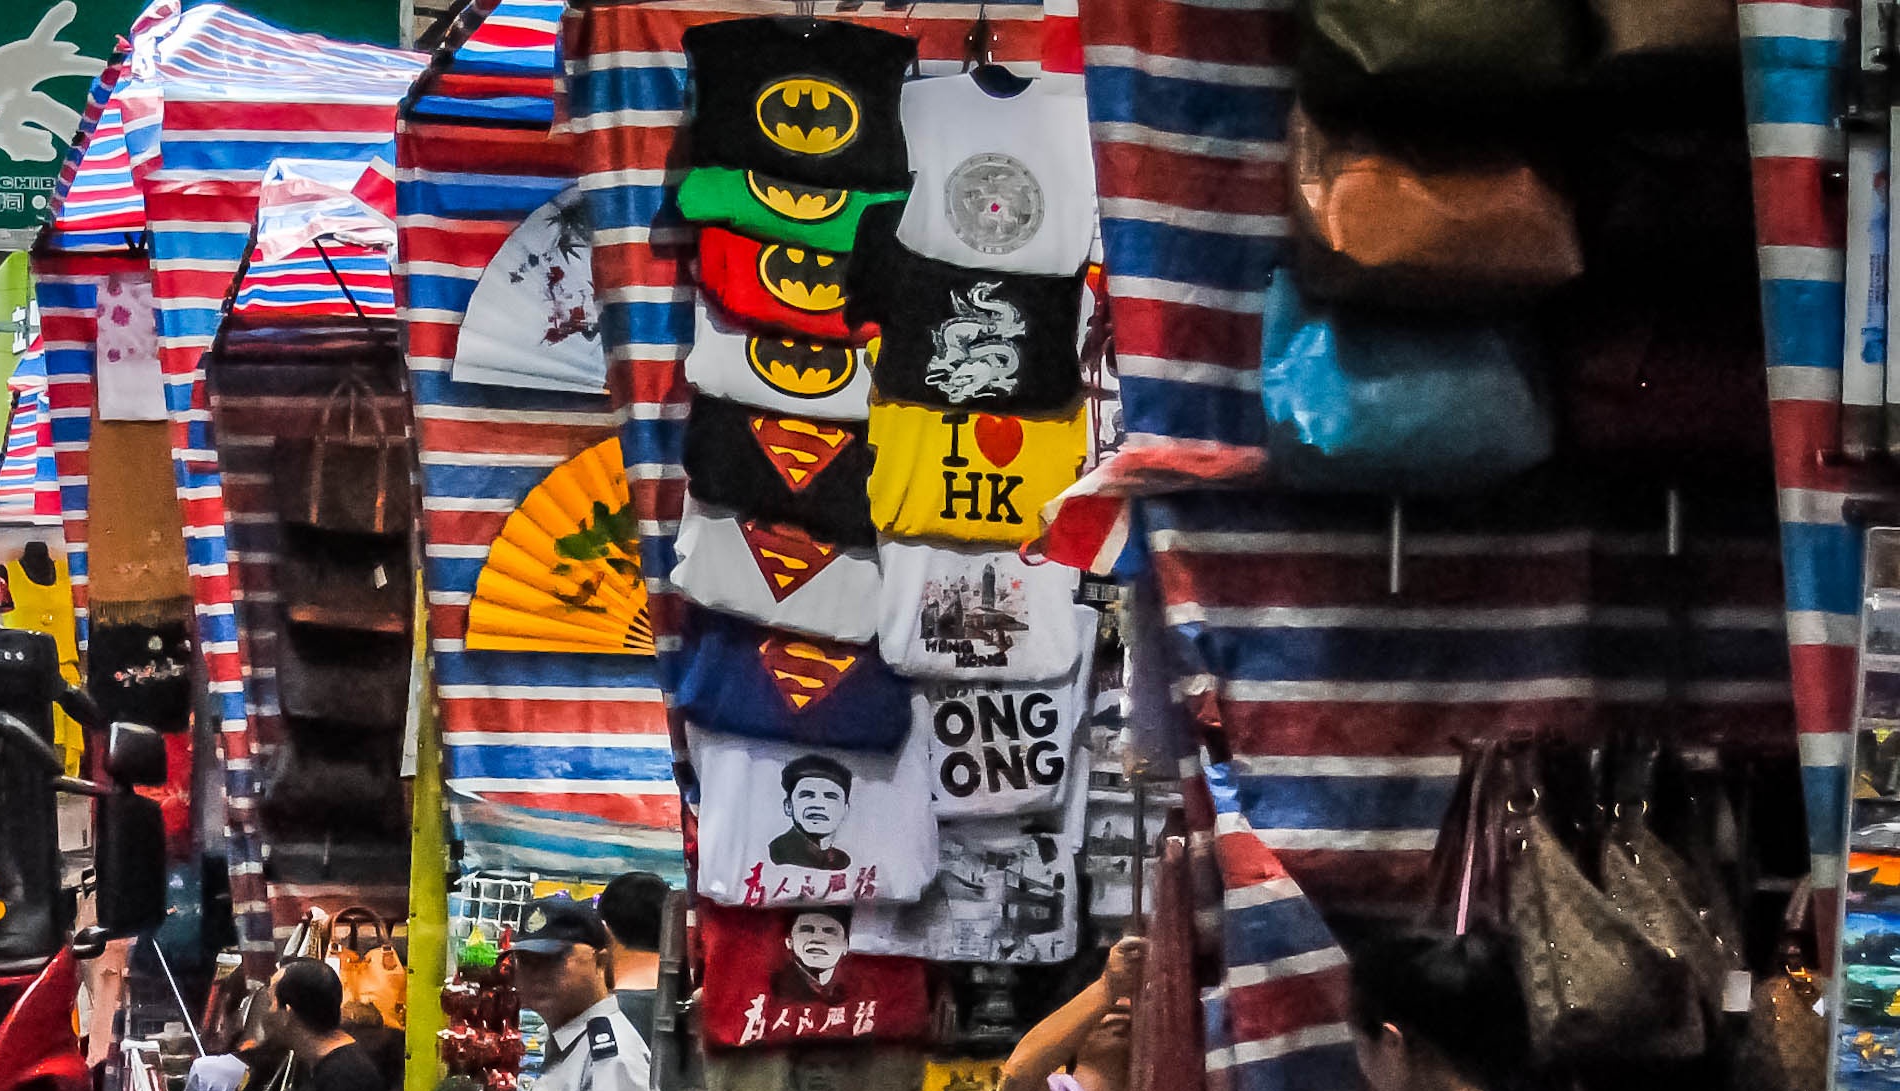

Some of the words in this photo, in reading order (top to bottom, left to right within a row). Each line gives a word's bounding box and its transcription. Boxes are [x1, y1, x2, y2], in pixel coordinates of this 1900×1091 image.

[941, 412, 969, 467] I
[940, 471, 1024, 525] HK
[933, 692, 1058, 747] ONG
[938, 740, 1064, 797] ONG
